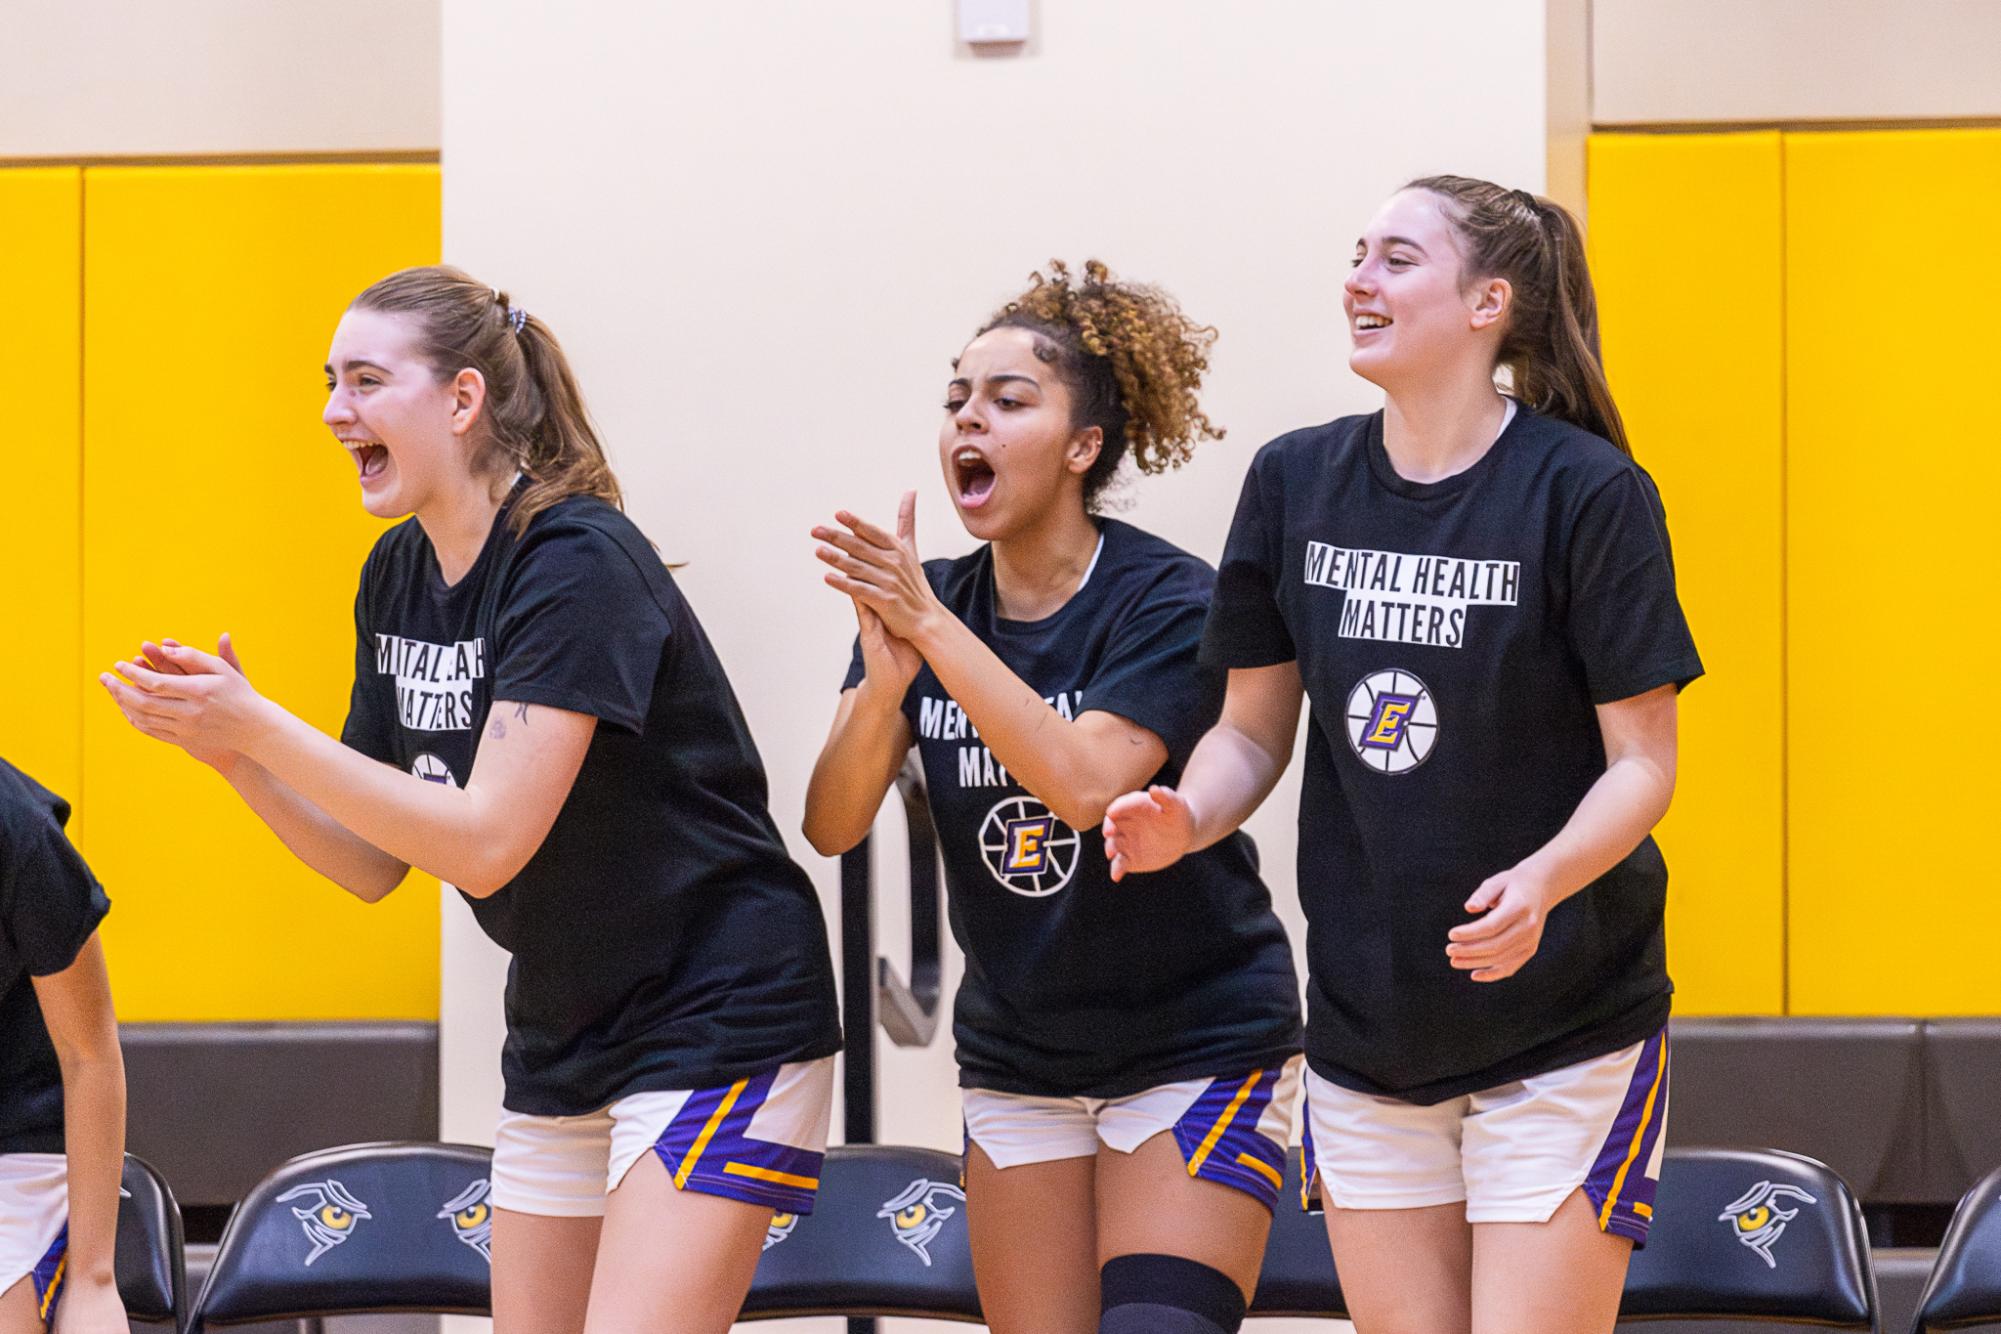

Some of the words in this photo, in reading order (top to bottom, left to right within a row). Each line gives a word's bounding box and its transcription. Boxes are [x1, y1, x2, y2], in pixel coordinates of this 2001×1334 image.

[1305, 543, 1402, 593] MENTAL
[1411, 556, 1521, 603] HEALTH
[1340, 597, 1464, 647] MATTERS
[376, 635, 444, 683] MTAL
[1365, 701, 1412, 745] E
[1008, 824, 1045, 869] E
